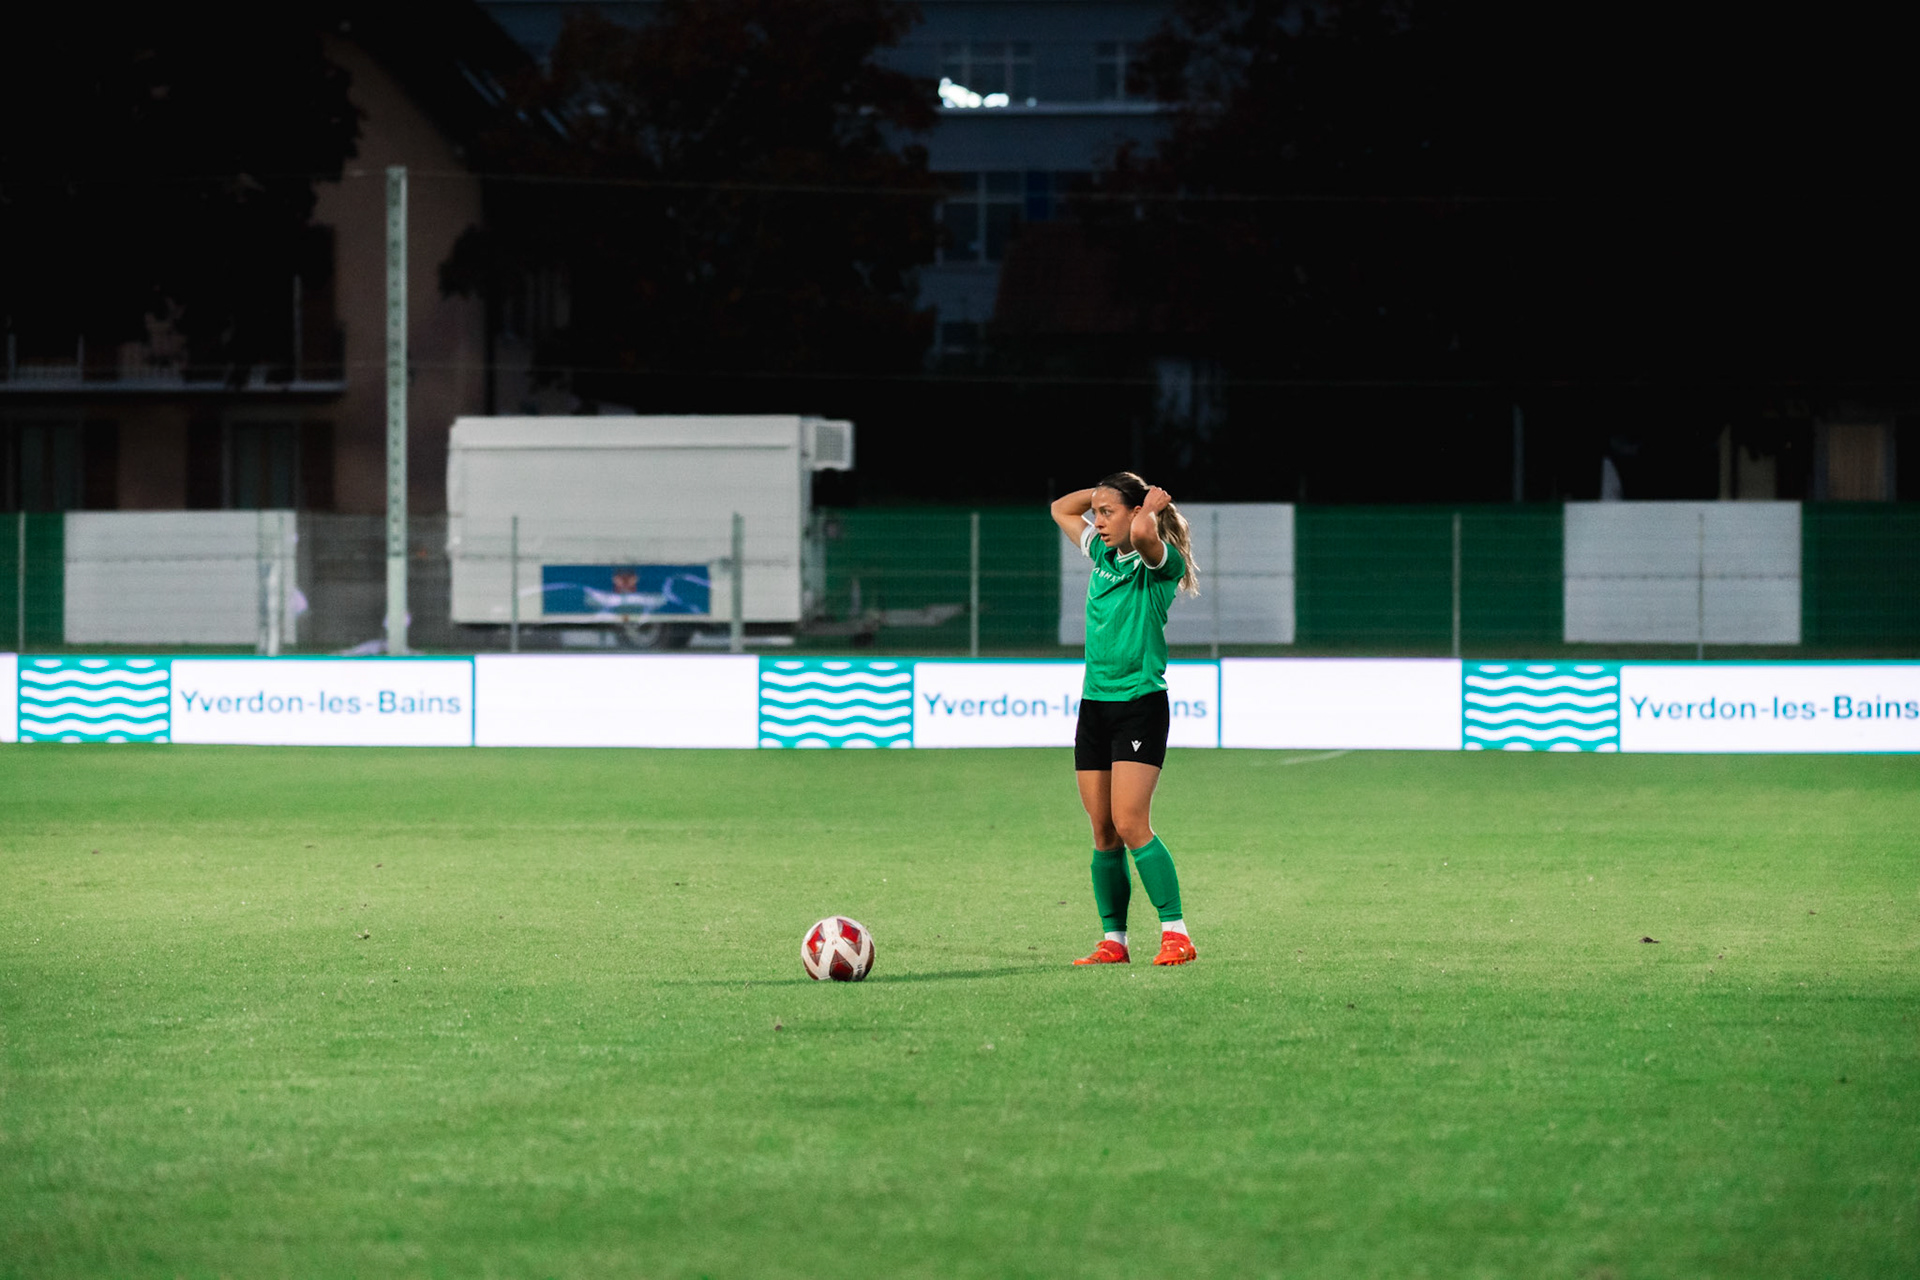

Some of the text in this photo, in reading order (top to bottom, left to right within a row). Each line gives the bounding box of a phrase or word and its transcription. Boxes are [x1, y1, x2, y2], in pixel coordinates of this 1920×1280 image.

[180, 689, 462, 713] Yverdon-les-Bains
[922, 692, 1207, 718] Yverdon-lns
[1630, 694, 1919, 720] Yverdon-les-Bains
